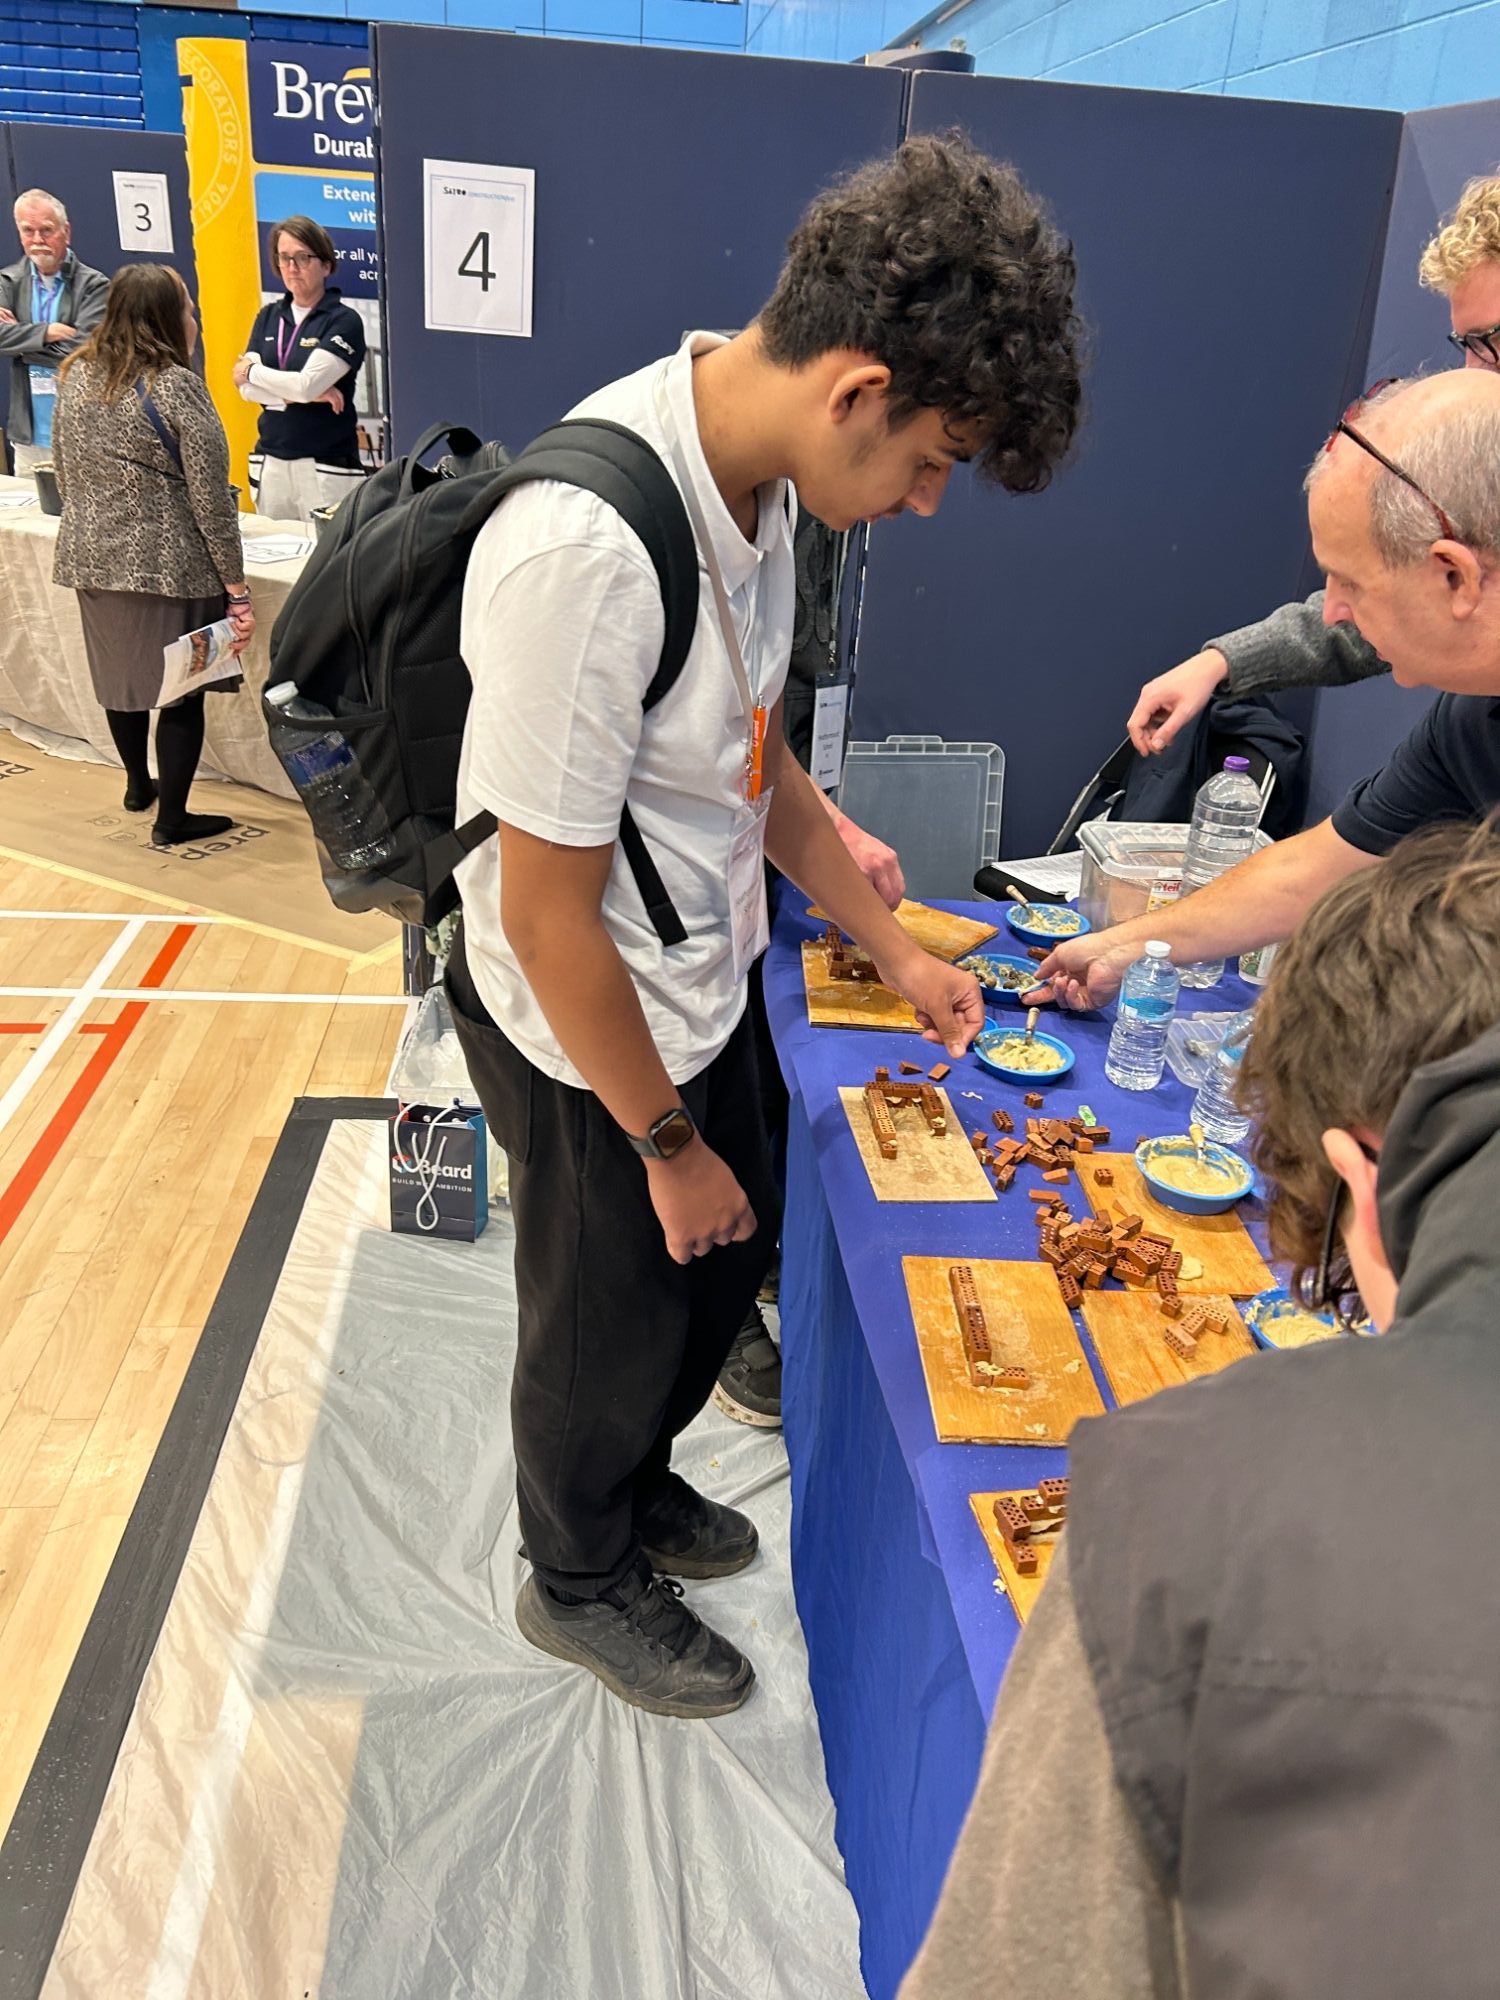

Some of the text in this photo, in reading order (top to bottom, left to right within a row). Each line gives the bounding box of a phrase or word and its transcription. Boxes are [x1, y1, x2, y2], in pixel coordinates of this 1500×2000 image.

[134, 203, 152, 232] 3
[349, 247, 365, 261] all
[458, 232, 496, 292] 4
[180, 825, 271, 860] prep
[436, 1183, 472, 1192] AMBITION
